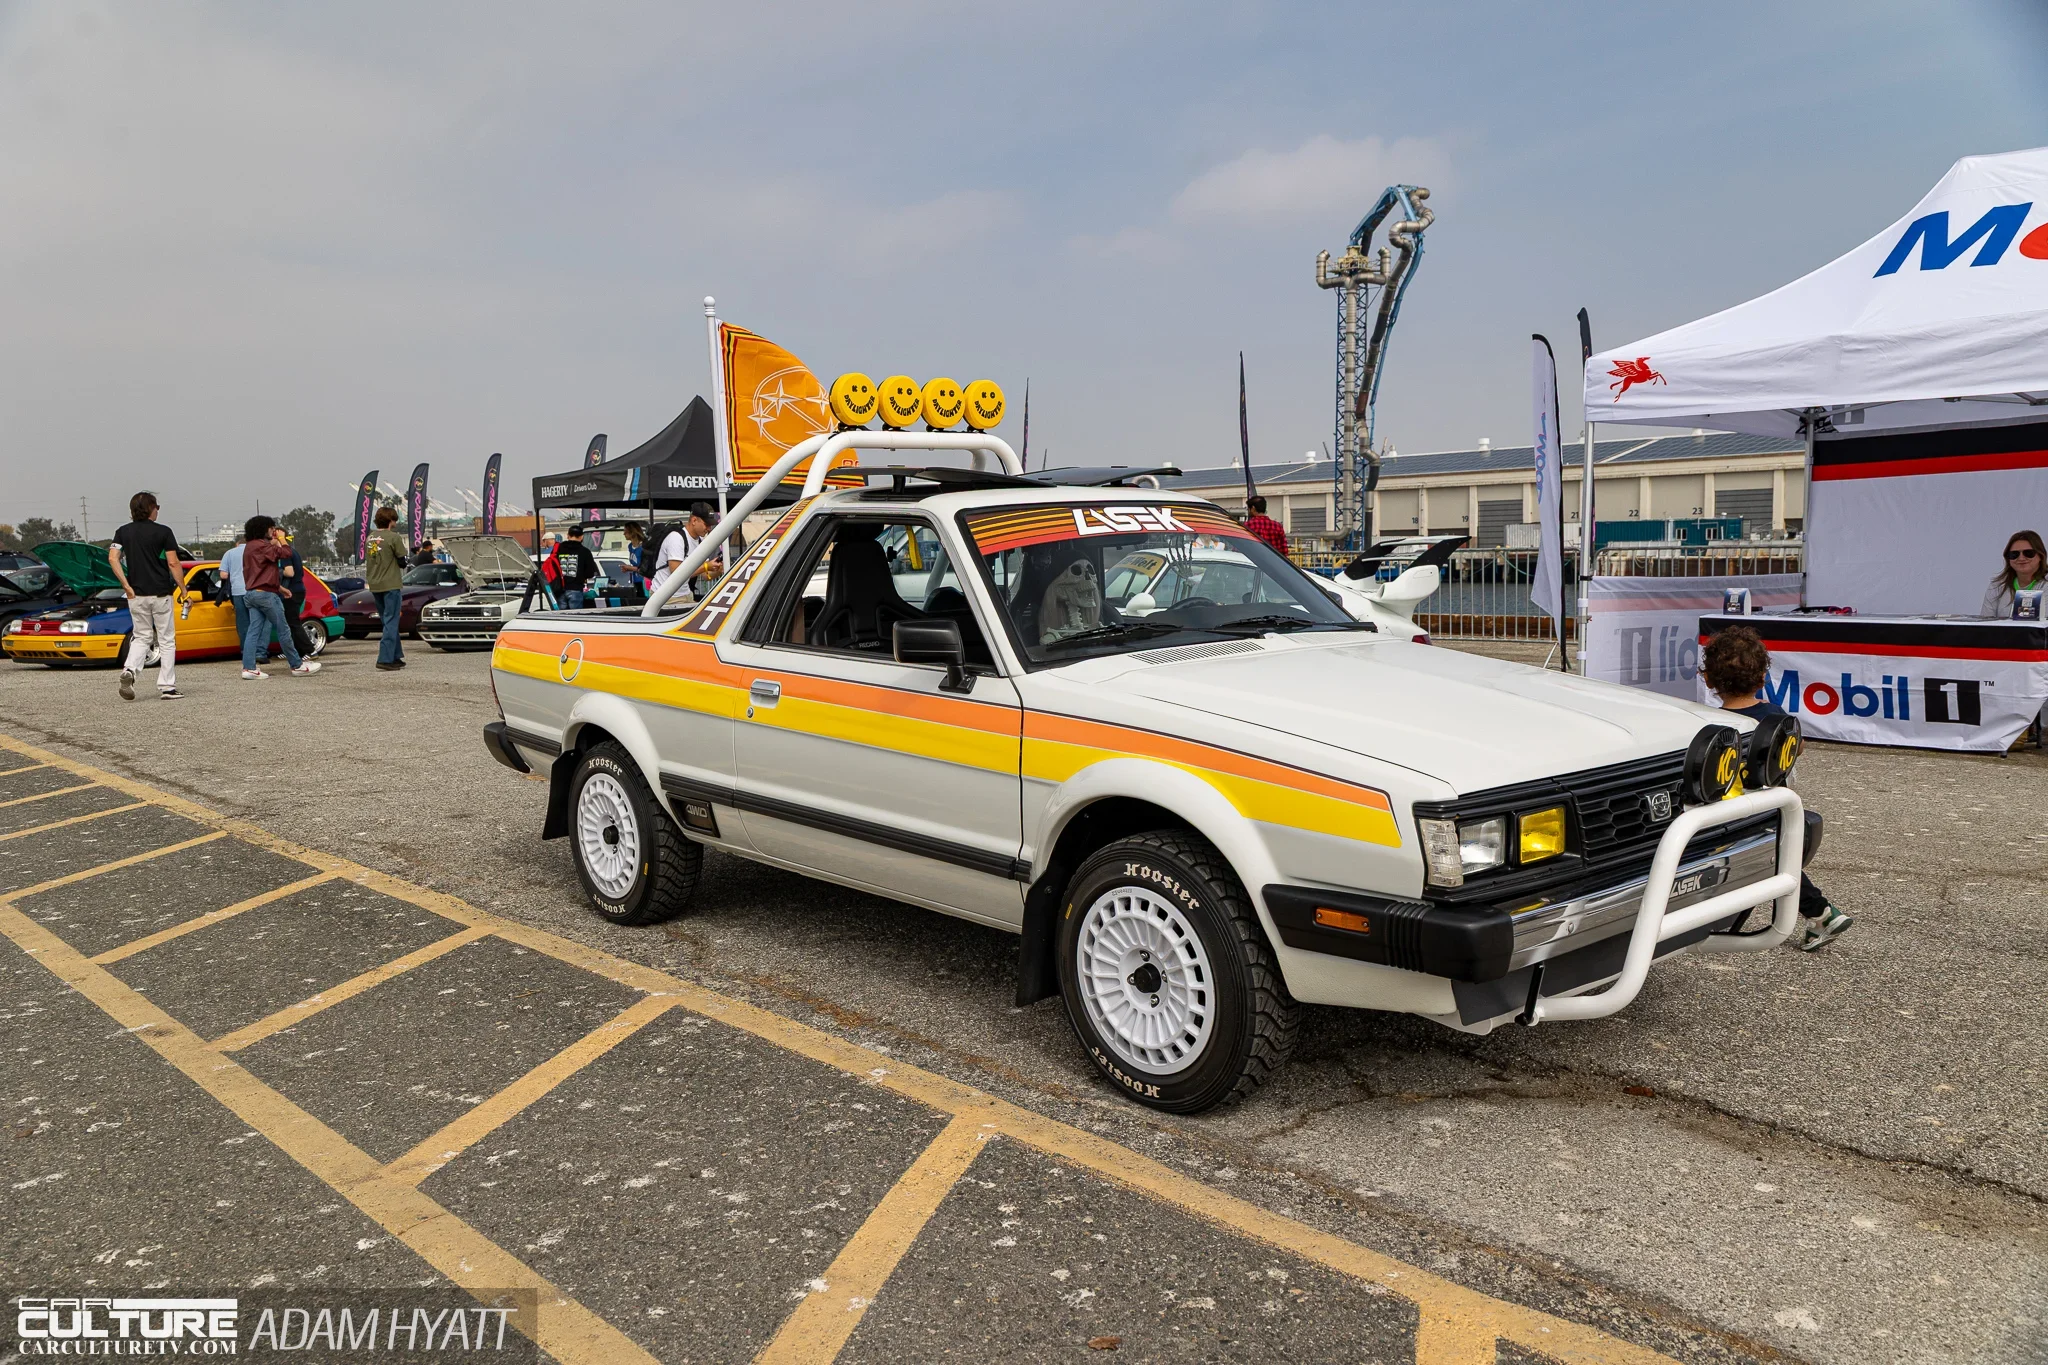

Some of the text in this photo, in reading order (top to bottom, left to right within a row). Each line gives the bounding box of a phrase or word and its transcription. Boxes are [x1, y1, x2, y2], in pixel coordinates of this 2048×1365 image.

[844, 394, 875, 415] DAYLIGHTER
[889, 396, 920, 416] DAYLIGHTER
[932, 398, 962, 418] DAYLIGHTER
[974, 400, 1002, 419] DAYLIGHTER
[541, 484, 568, 498] HAGERTY
[587, 482, 598, 491] Club
[668, 475, 719, 488] HAGERTY
[1461, 515, 1469, 523] 19
[1570, 511, 1579, 519] 21
[1628, 509, 1639, 517] 22
[1692, 507, 1703, 515] 23
[699, 538, 778, 631] BRAT
[1755, 669, 1910, 721] Mobil
[1779, 735, 1797, 771] KC
[588, 758, 623, 776] Hoosier
[1716, 747, 1737, 785] KC
[1123, 863, 1200, 911] Hoosier
[1091, 1046, 1161, 1098] Hoosier
